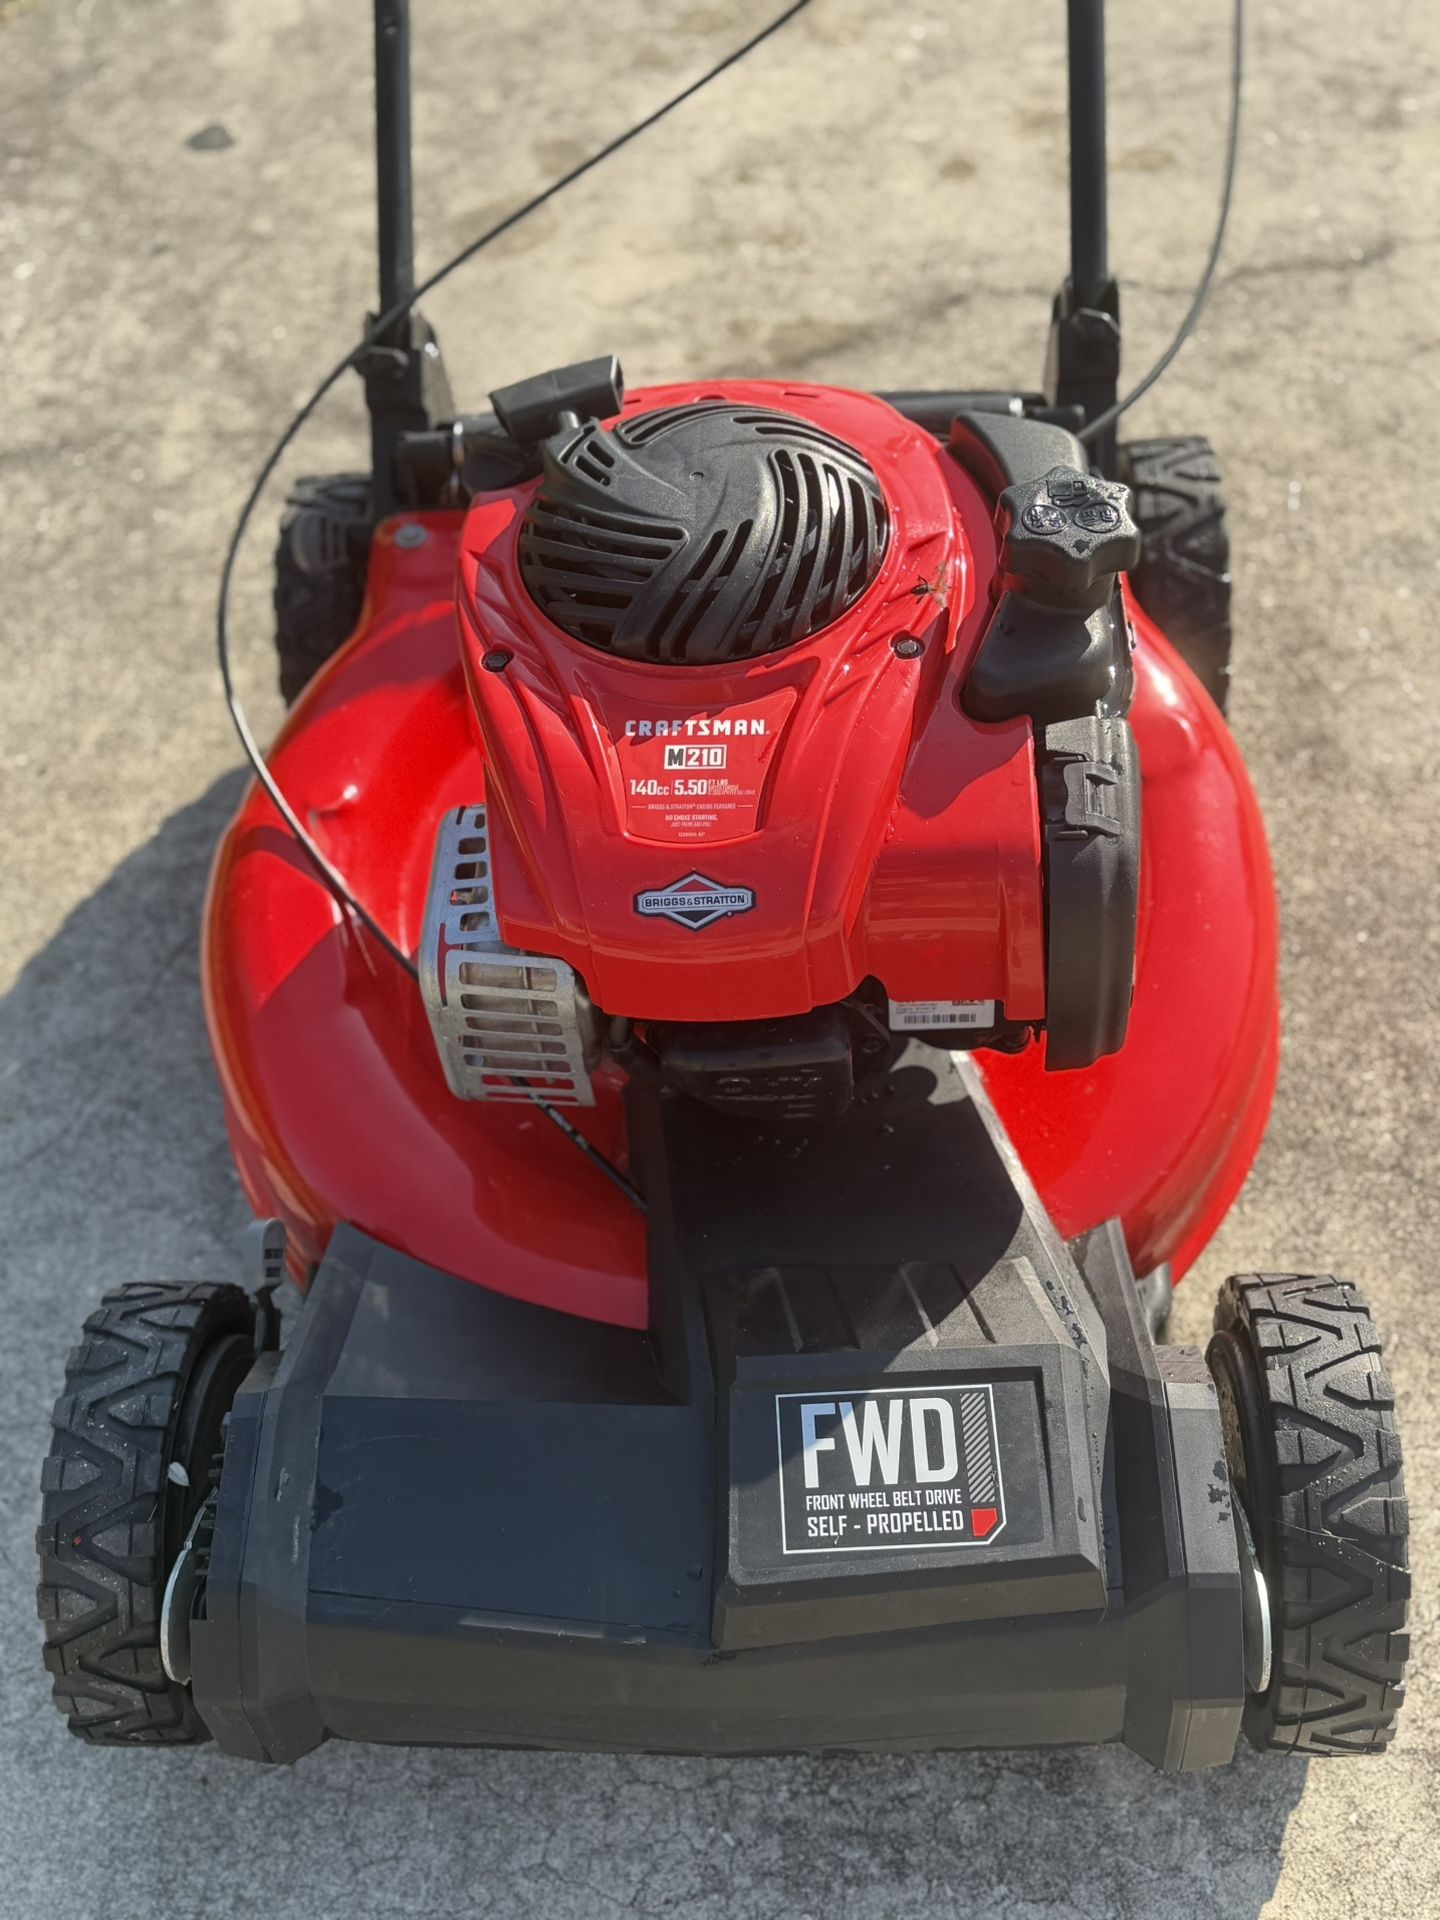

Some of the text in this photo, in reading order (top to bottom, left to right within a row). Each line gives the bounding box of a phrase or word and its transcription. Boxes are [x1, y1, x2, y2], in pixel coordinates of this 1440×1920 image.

[625, 719, 766, 737] CRAFTSMAN
[668, 748, 722, 766] M210
[630, 779, 669, 795] 140cc
[674, 779, 707, 796] 5.50
[801, 1398, 958, 1488] FWD
[805, 1488, 962, 1511] FRONT WHEEL BELT DRIVE
[807, 1515, 847, 1537] SELF
[867, 1510, 964, 1534] PROPELLED
